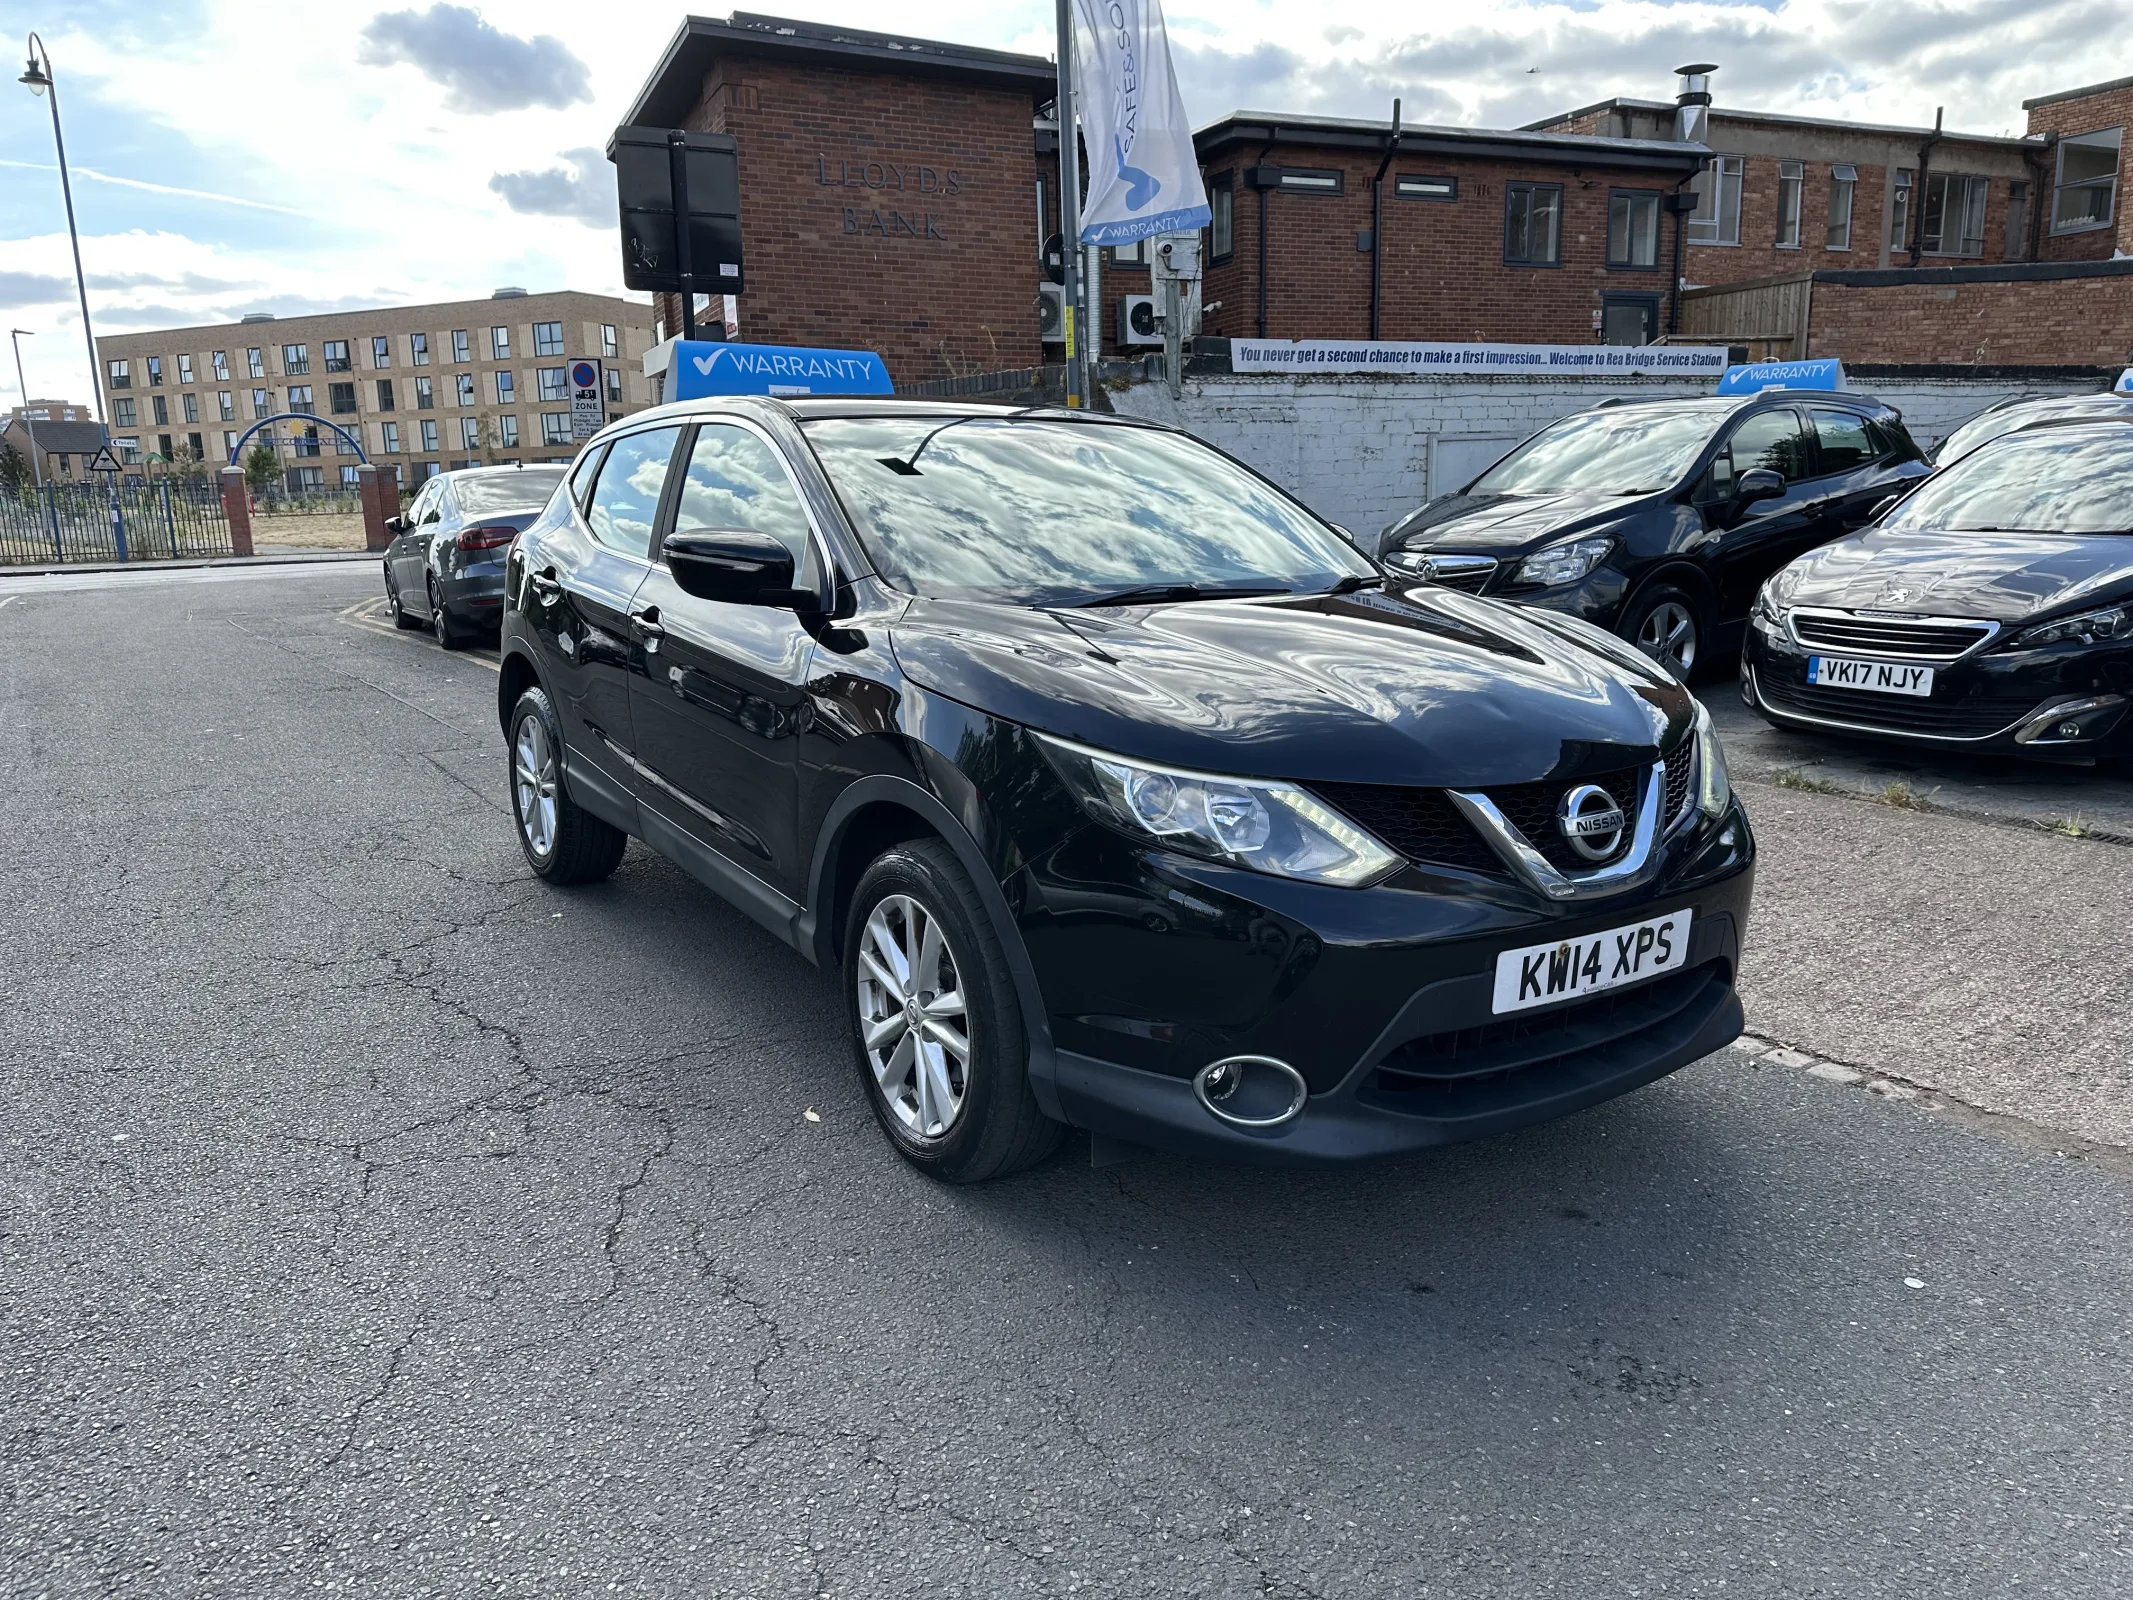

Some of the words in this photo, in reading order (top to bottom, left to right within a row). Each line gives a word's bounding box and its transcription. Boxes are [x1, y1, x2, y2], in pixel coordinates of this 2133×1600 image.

[1106, 0, 1137, 153] SAFE&SO
[819, 157, 961, 195] LLOYDS
[842, 207, 948, 240] BANK
[1108, 215, 1181, 239] WARRANTY
[729, 352, 871, 380] WARRANTY
[1241, 346, 1260, 362] You
[1262, 348, 1296, 362] never
[1297, 348, 1317, 364] get
[1318, 350, 1325, 363] a
[1327, 348, 1367, 363] second
[1369, 349, 1409, 363] chance
[1411, 349, 1422, 363] to
[1424, 349, 1453, 364] make
[1454, 352, 1461, 364] a
[1462, 351, 1485, 365] first
[1486, 351, 1547, 366] impression...
[1549, 351, 1594, 366] Welcome
[1595, 352, 1605, 366] to
[1606, 352, 1624, 366] Rea
[1625, 352, 1655, 368] Bridge
[1656, 353, 1690, 367] Service
[1691, 353, 1722, 367] Station
[1749, 364, 1831, 380] WARRANTY
[1827, 661, 1872, 684] VK17
[1877, 666, 1924, 689] NJY
[1576, 815, 1623, 832] NISSAN
[1518, 940, 1602, 1001] KW14
[1611, 921, 1674, 979] XPS
